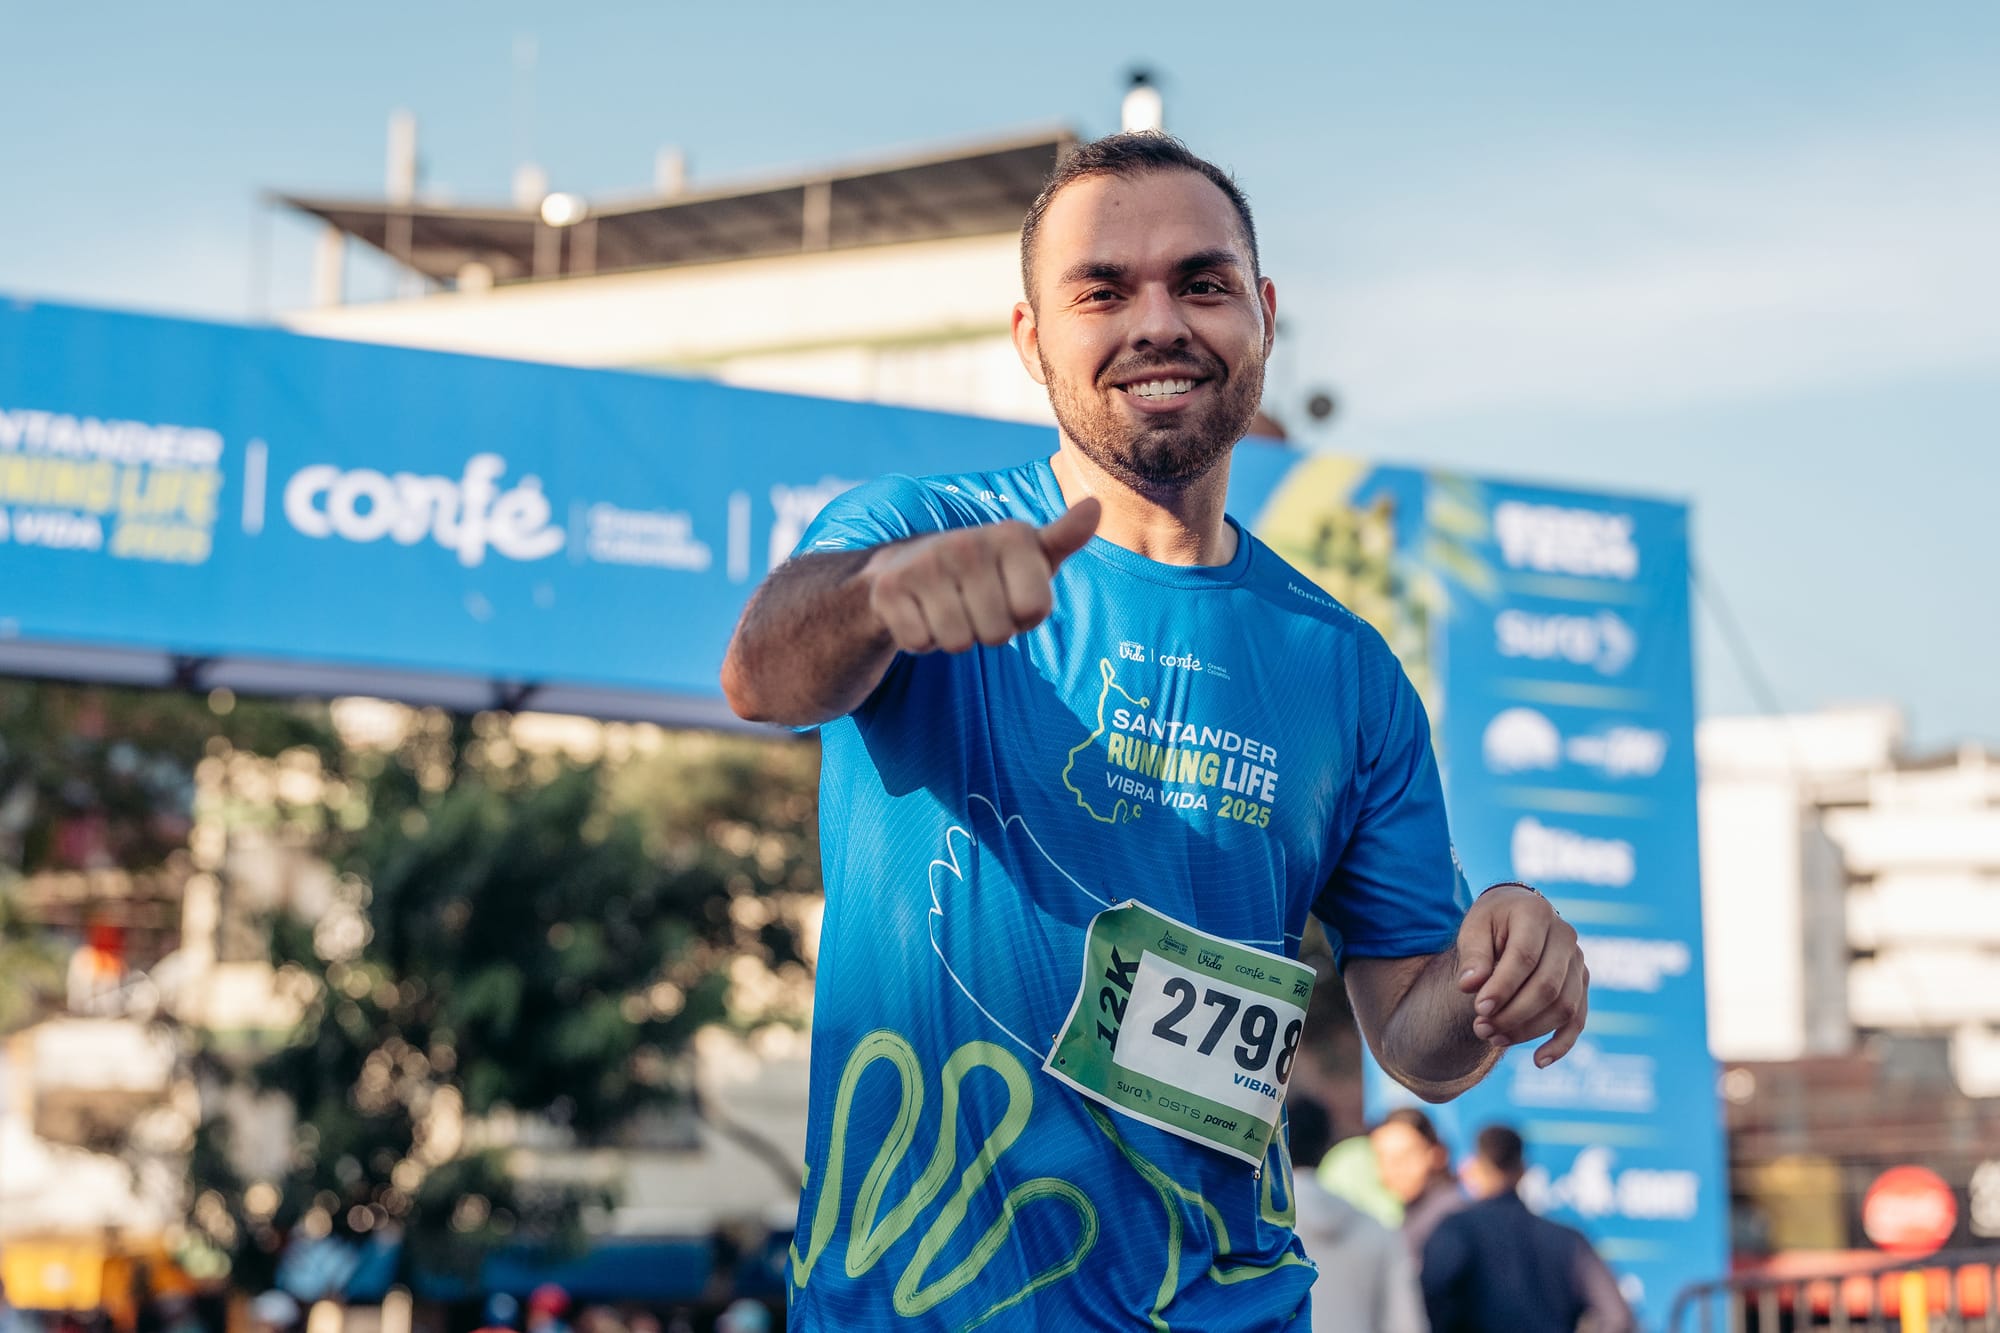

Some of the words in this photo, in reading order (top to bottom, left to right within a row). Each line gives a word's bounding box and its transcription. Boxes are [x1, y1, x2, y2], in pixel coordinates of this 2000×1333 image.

[282, 452, 566, 567] confé
[1160, 653, 1203, 671] confé
[1112, 708, 1278, 767] SANTANDER
[1107, 732, 1221, 787] RUNNING
[1222, 757, 1279, 804] LIFE
[1105, 771, 1155, 803] VIBRA
[1160, 791, 1208, 811] VIDA
[1217, 795, 1272, 829] 2025
[1198, 952, 1223, 971] Vida
[1235, 965, 1265, 980] confé
[1096, 944, 1141, 1053] 12K
[1151, 977, 1303, 1085] 2798
[1117, 1080, 1143, 1098] sura
[1233, 1073, 1277, 1100] VIBRA
[1158, 1096, 1201, 1120] OSTS
